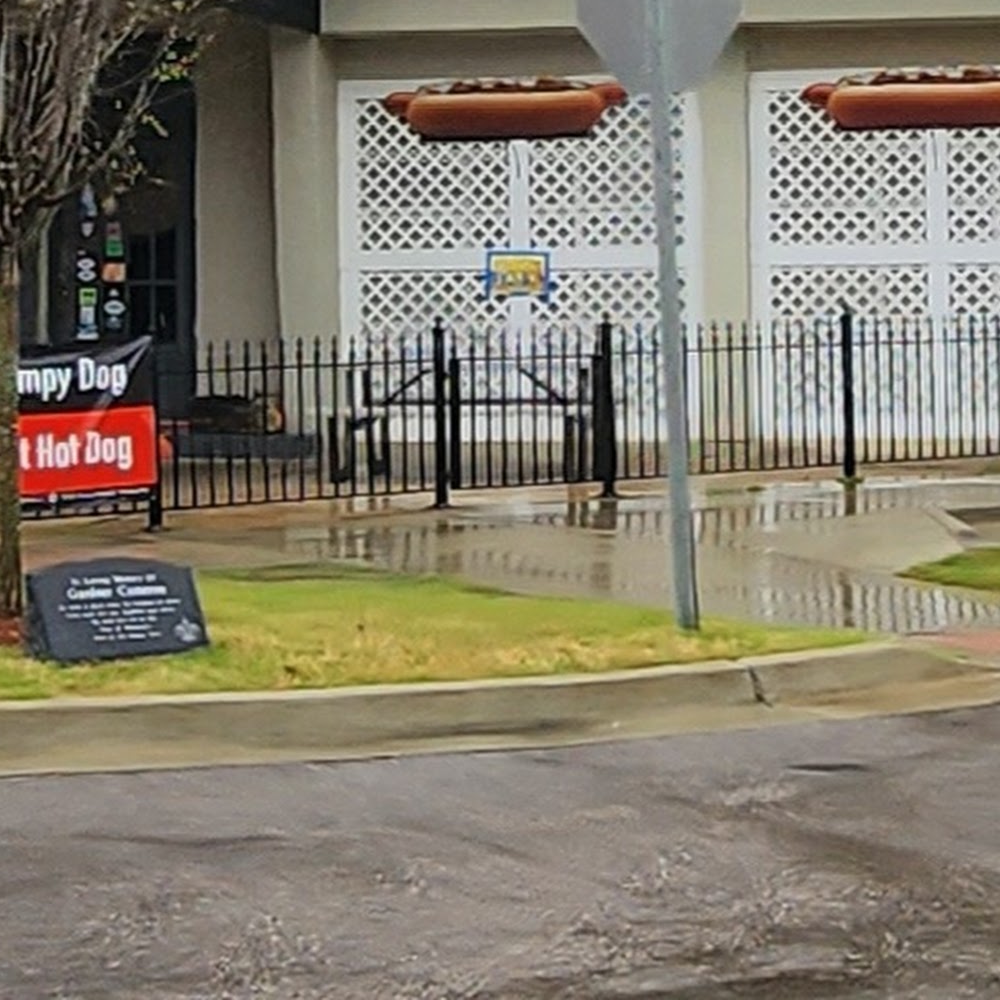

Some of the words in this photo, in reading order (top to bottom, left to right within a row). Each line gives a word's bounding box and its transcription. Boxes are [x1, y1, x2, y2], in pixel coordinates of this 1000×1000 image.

[78, 356, 128, 397] Dog
[37, 432, 81, 470] Hot
[85, 430, 134, 471] Dog
